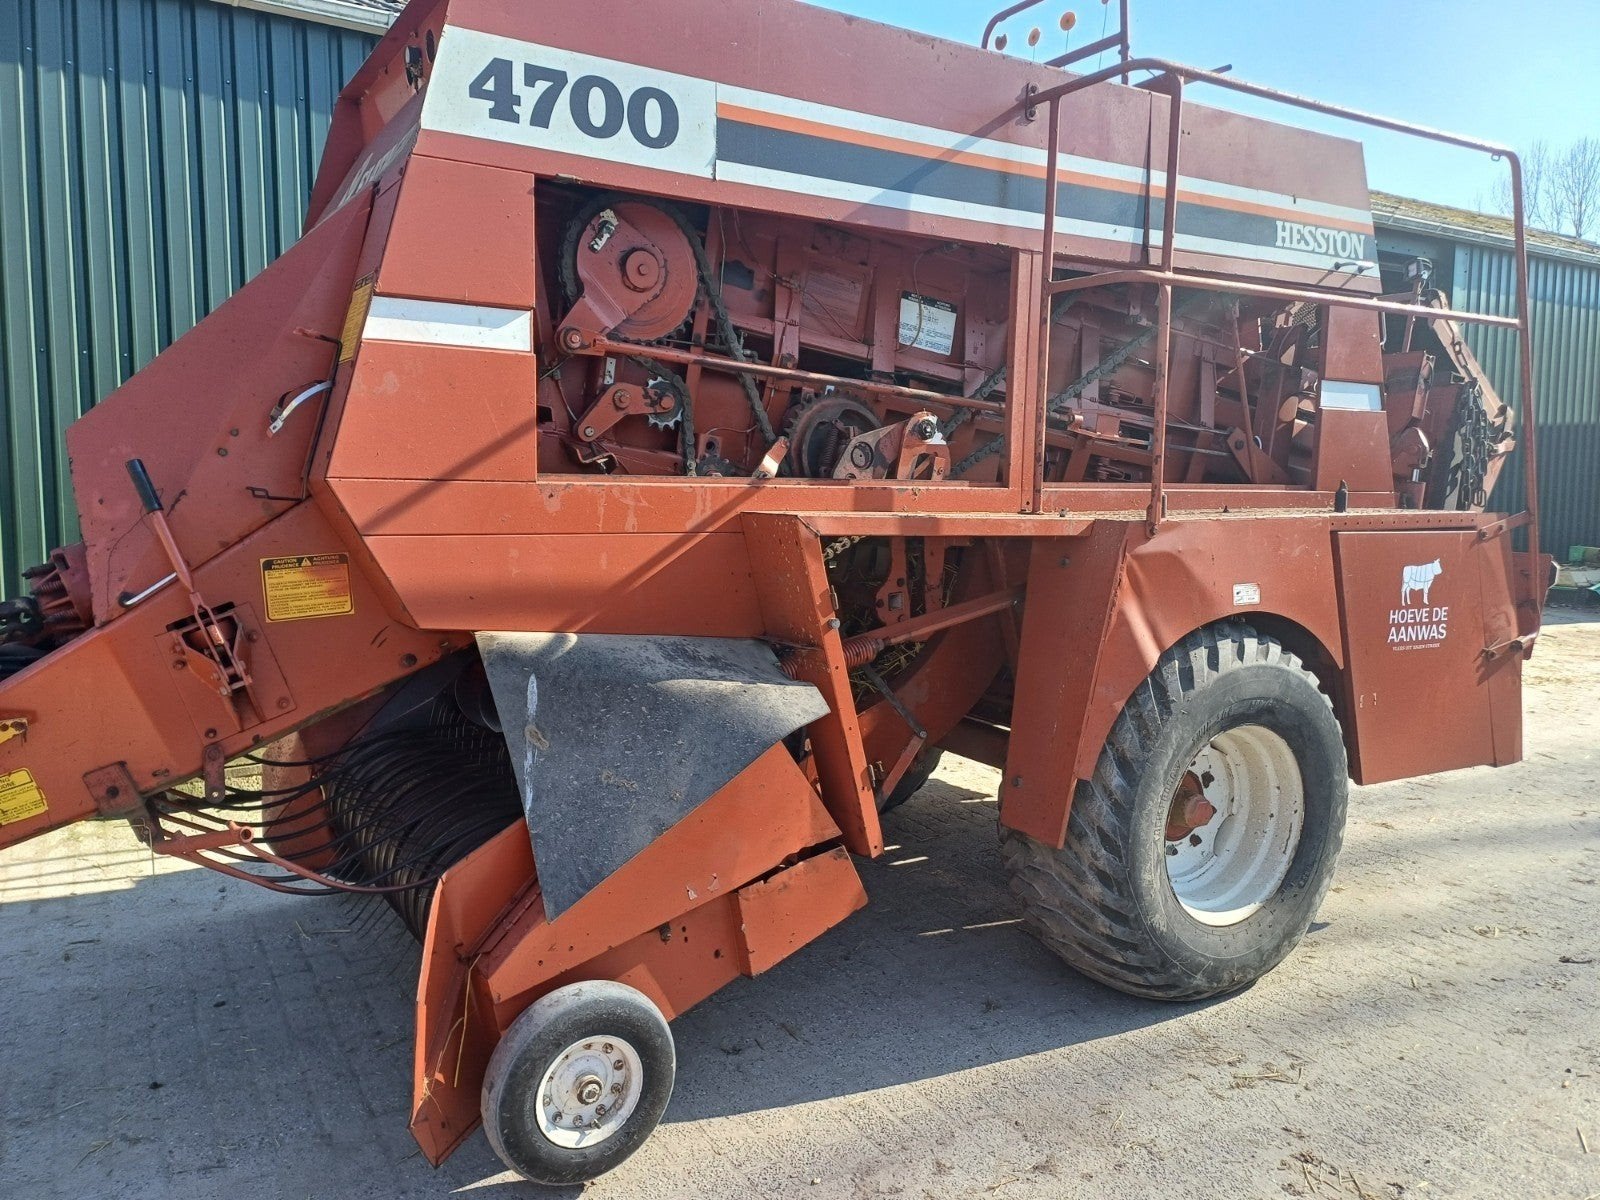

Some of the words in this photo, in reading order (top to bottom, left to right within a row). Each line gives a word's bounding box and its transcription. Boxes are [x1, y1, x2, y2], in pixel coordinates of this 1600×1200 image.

[468, 57, 680, 149] 4700
[1275, 220, 1366, 260] HESSTON
[1389, 608, 1430, 624] HOEVE
[1432, 606, 1449, 622] DE
[1387, 623, 1447, 643] AANWAS
